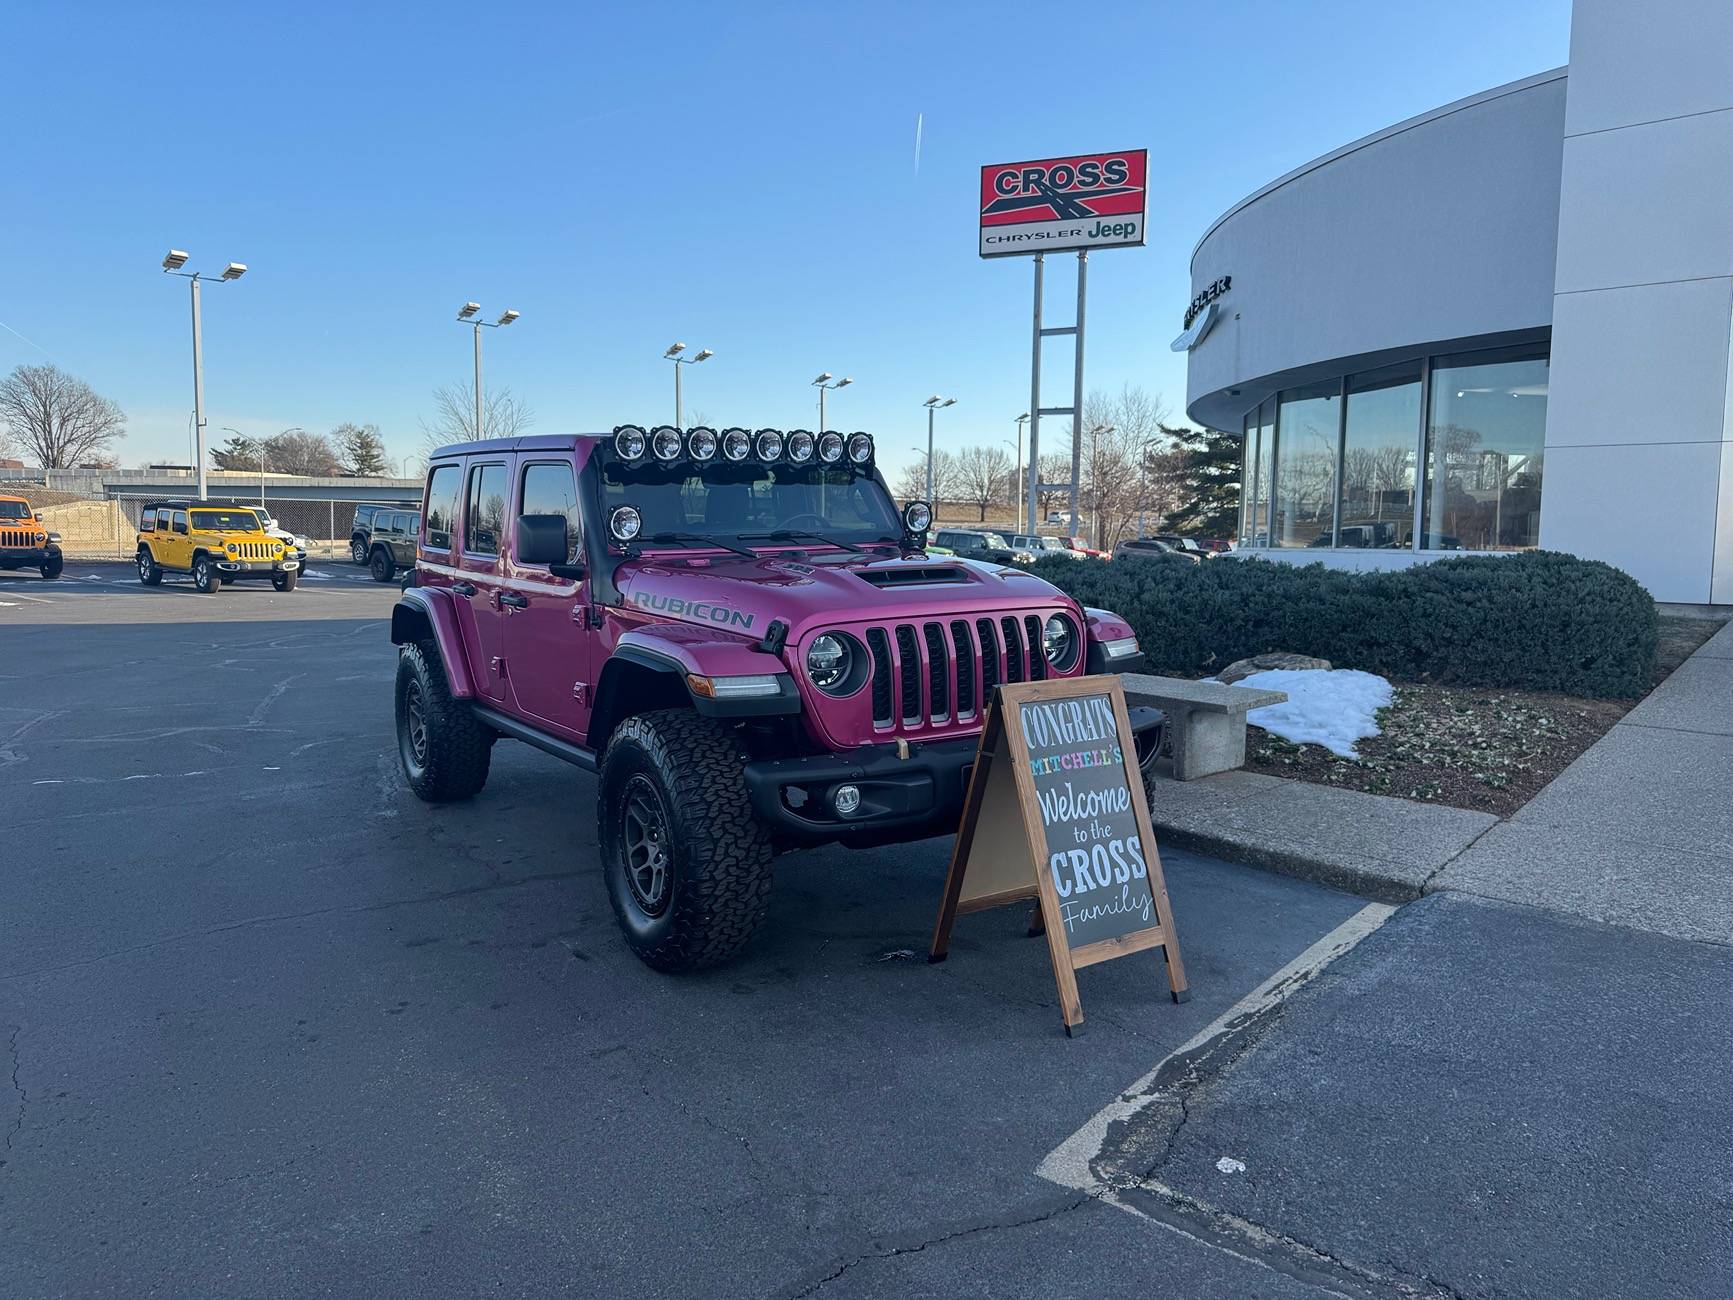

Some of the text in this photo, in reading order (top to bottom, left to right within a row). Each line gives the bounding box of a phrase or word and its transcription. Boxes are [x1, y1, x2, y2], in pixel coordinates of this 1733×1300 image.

[994, 159, 1129, 197] CROSS
[985, 221, 1136, 244] CHRYSLER Jeep
[634, 591, 755, 629] RUBICON
[1020, 697, 1117, 750] CONGRATS
[1030, 745, 1123, 776] MITCHELL'S
[1036, 782, 1131, 827] Welcome
[1073, 820, 1113, 843] to the
[1050, 835, 1147, 898] CROSS
[1059, 884, 1153, 933] Family
